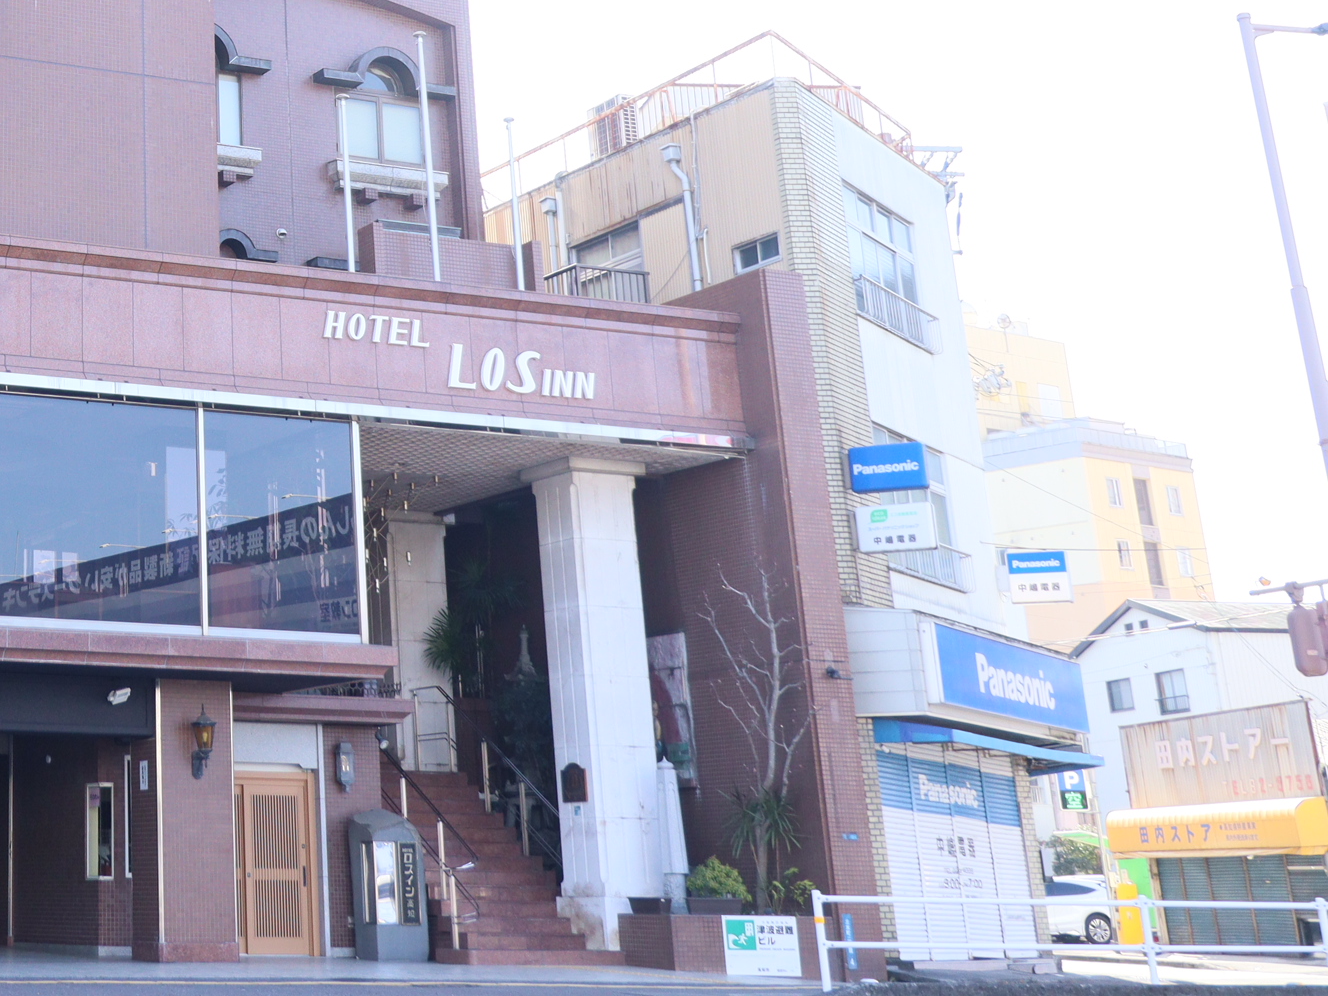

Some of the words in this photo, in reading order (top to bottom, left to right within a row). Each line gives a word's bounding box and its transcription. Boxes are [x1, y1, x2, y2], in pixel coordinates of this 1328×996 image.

[323, 310, 430, 348] HOTEL
[852, 459, 920, 476] Panasonic
[1012, 557, 1061, 569] Panasonic
[975, 652, 1056, 710] Panasonic
[1155, 728, 1289, 769] 田内ストアー
[1063, 771, 1080, 790] P
[918, 774, 979, 808] Panasonic
[1139, 824, 1211, 844] 田内ストア
[759, 937, 775, 945] ビル
